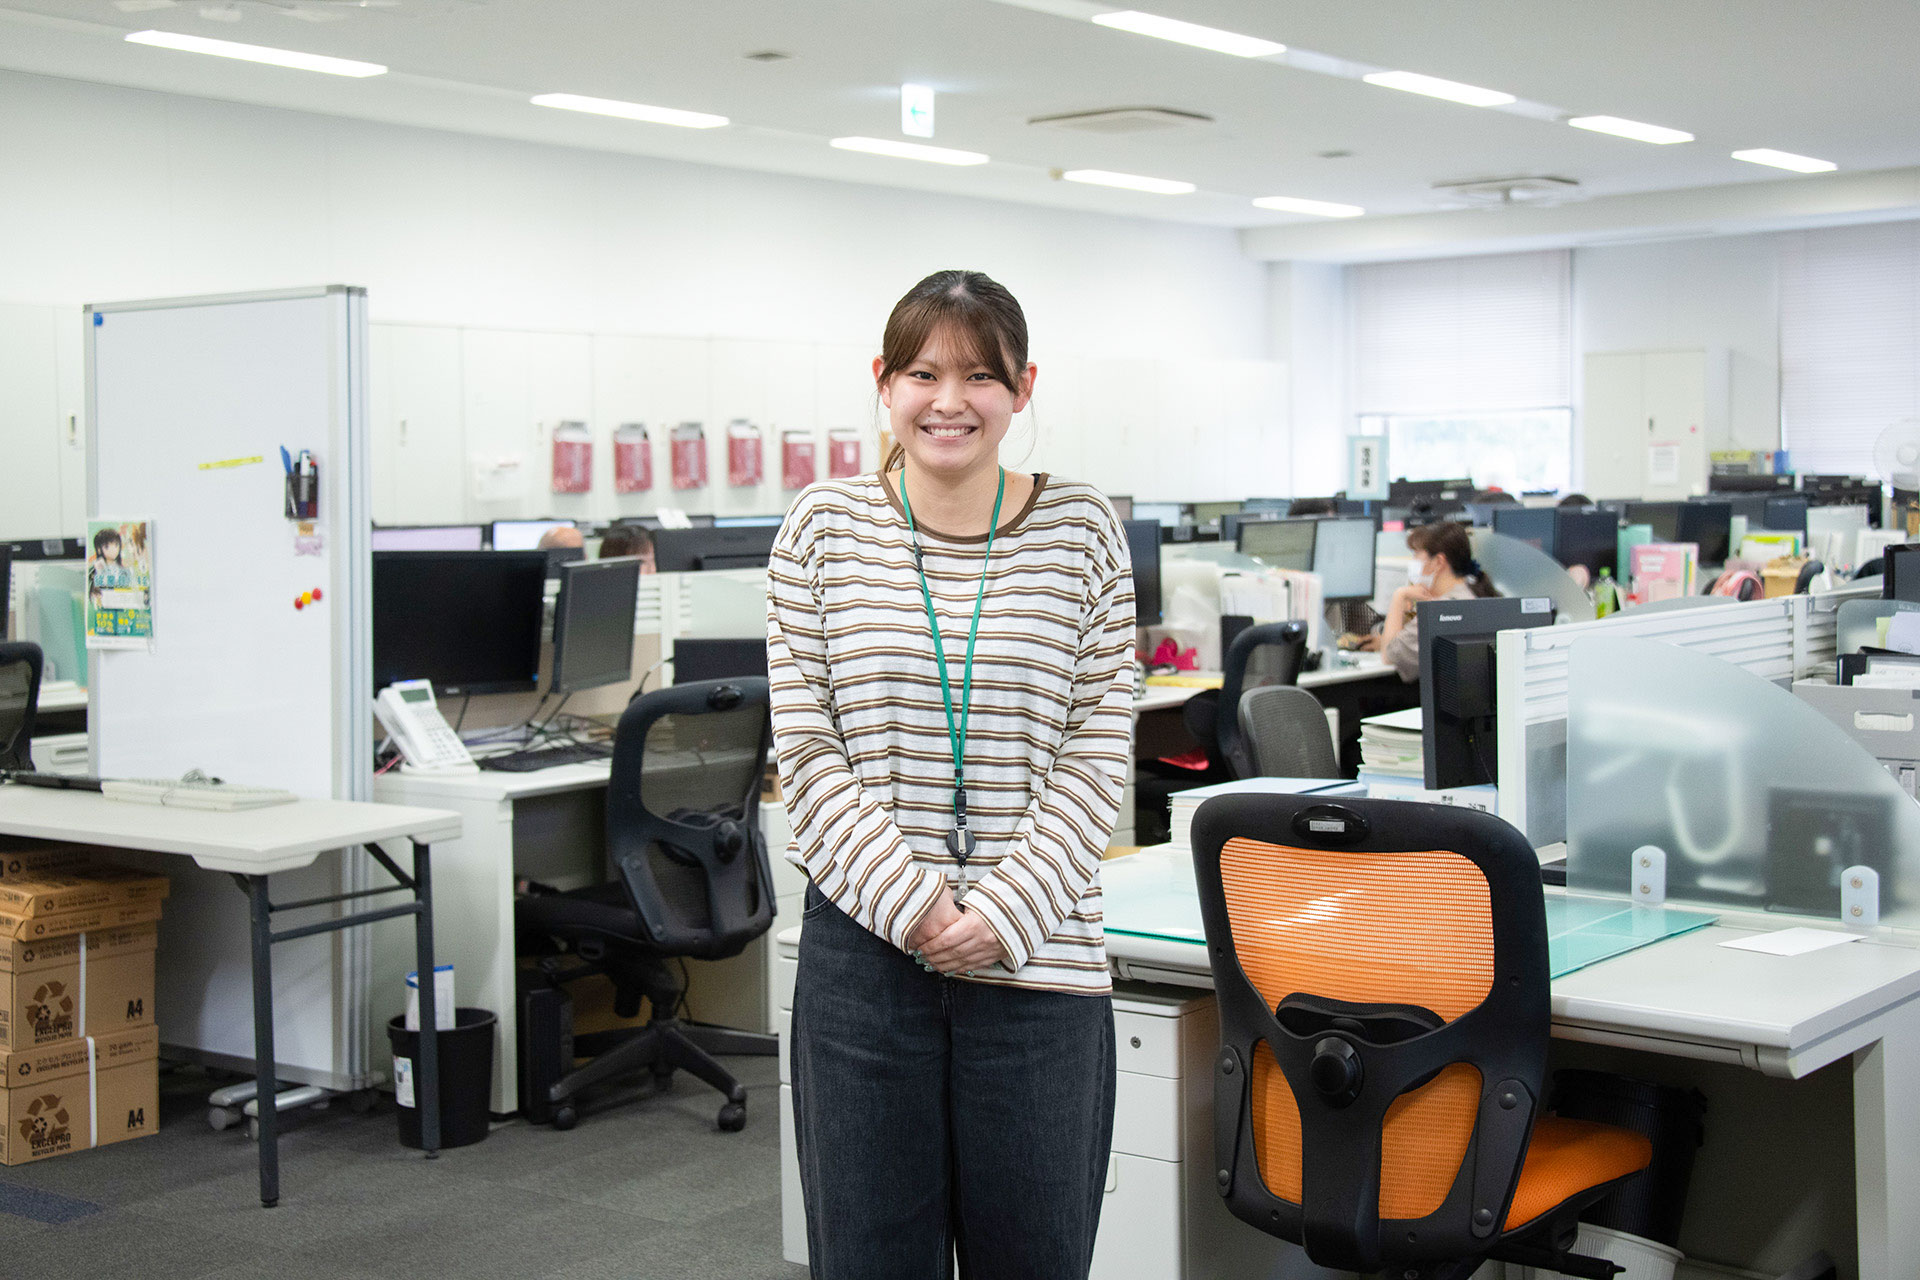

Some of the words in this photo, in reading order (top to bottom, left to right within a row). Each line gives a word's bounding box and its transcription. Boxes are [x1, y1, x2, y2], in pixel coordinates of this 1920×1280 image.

[127, 999, 143, 1019] A4
[128, 1108, 145, 1128] A4
[32, 1132, 71, 1149] EXCELPRO
